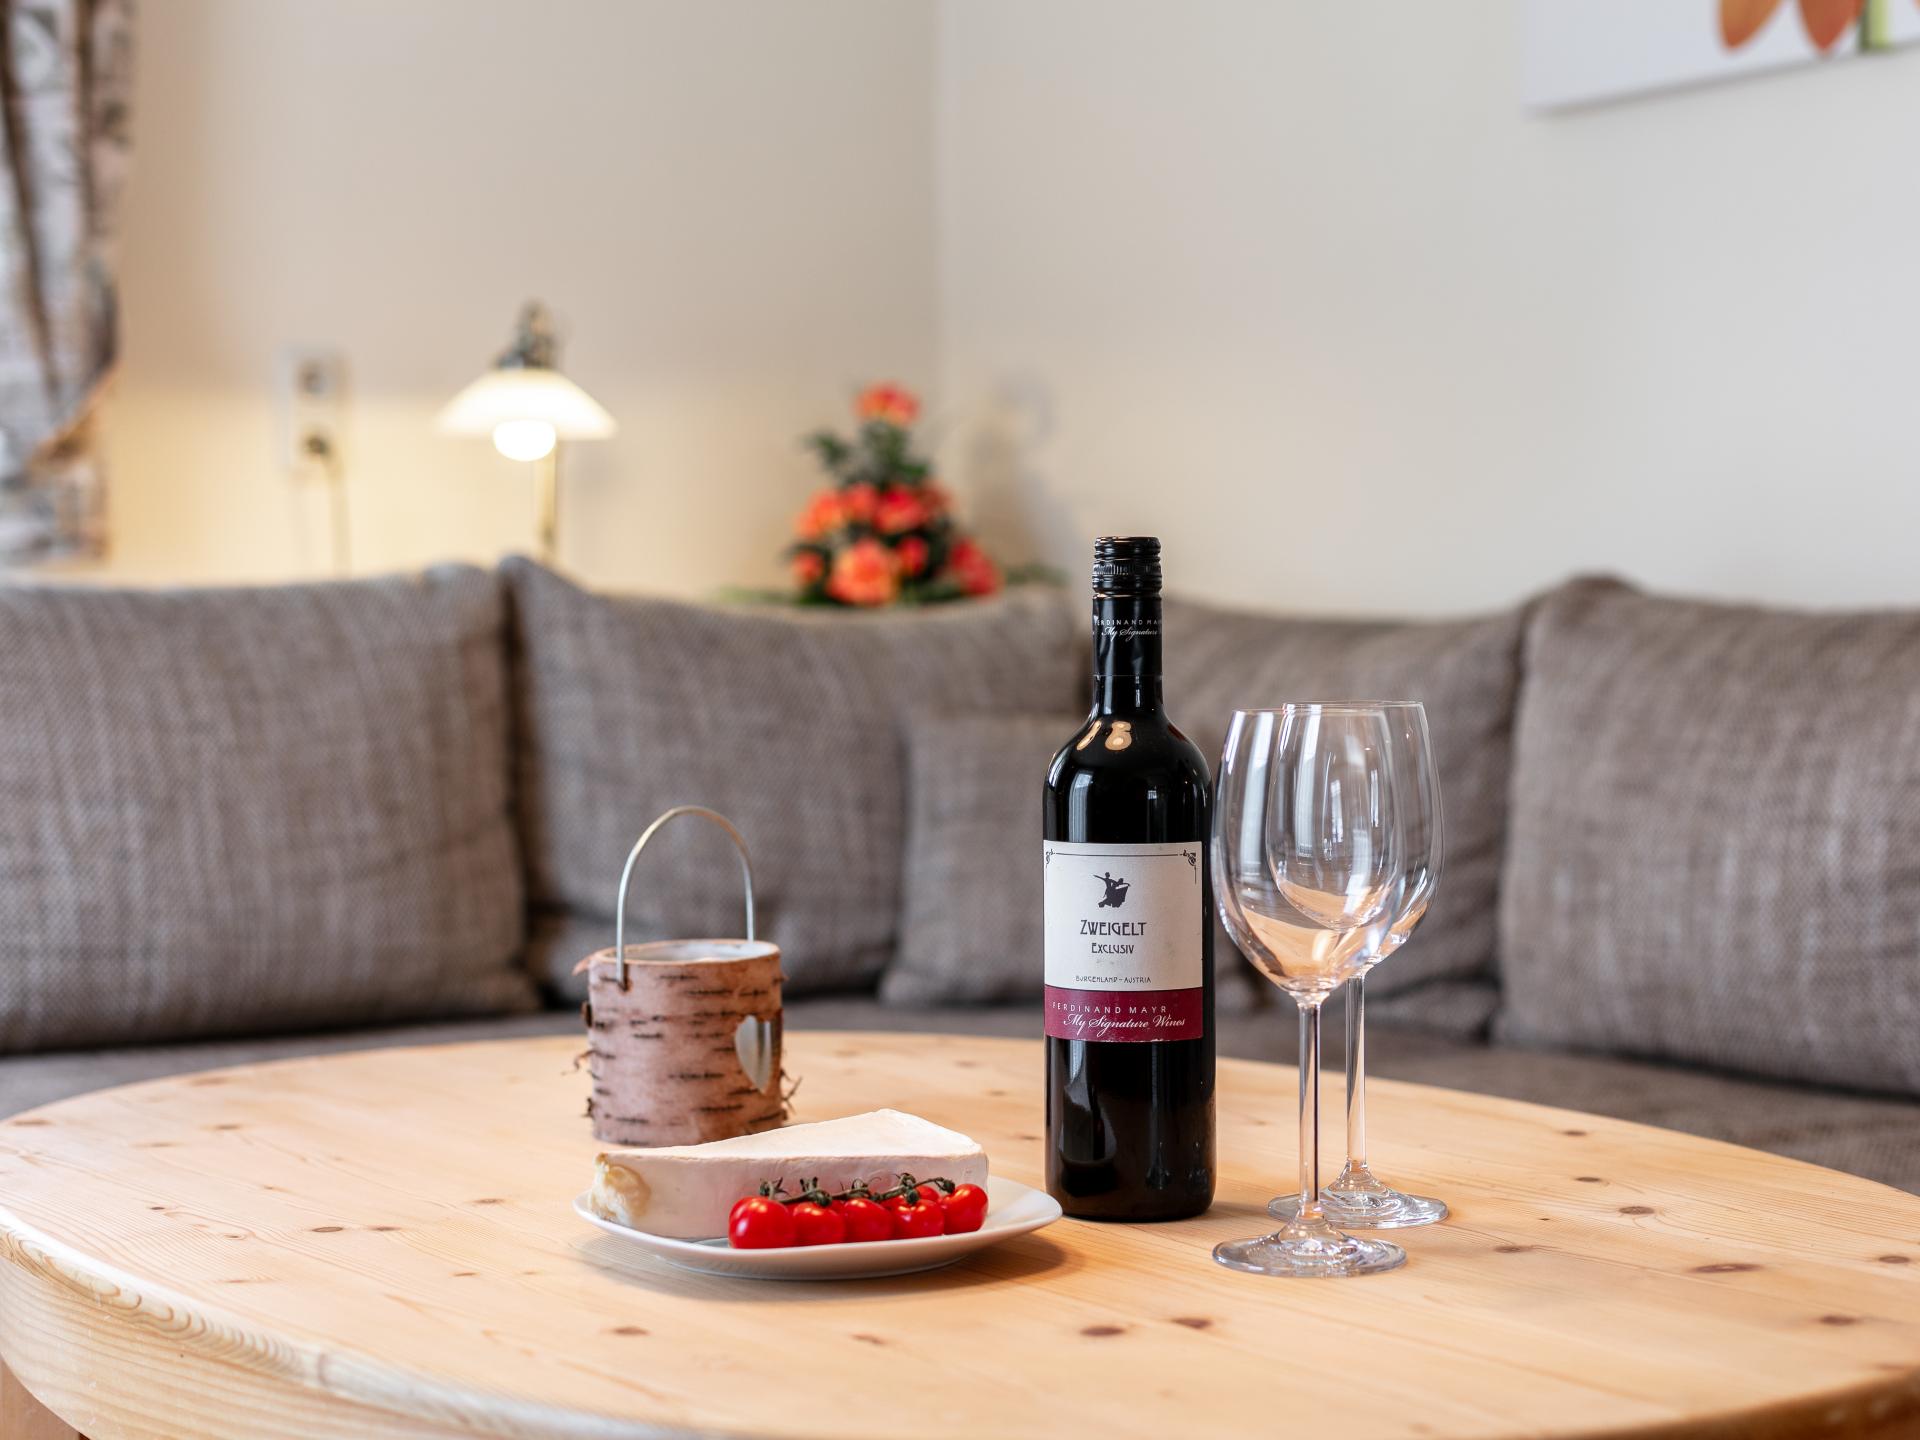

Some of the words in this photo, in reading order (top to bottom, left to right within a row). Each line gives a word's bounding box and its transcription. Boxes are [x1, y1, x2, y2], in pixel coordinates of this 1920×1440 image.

[1101, 626, 1118, 642] My
[1080, 919, 1147, 936] ZWEIGELT
[1091, 942, 1135, 954] EXCLUSIV
[1052, 1001, 1121, 1014] FERDINAND
[1129, 1005, 1167, 1014] MAYR
[1063, 1013, 1086, 1036] My
[1088, 1014, 1150, 1038] Signature
[1152, 1013, 1186, 1028] Wines
